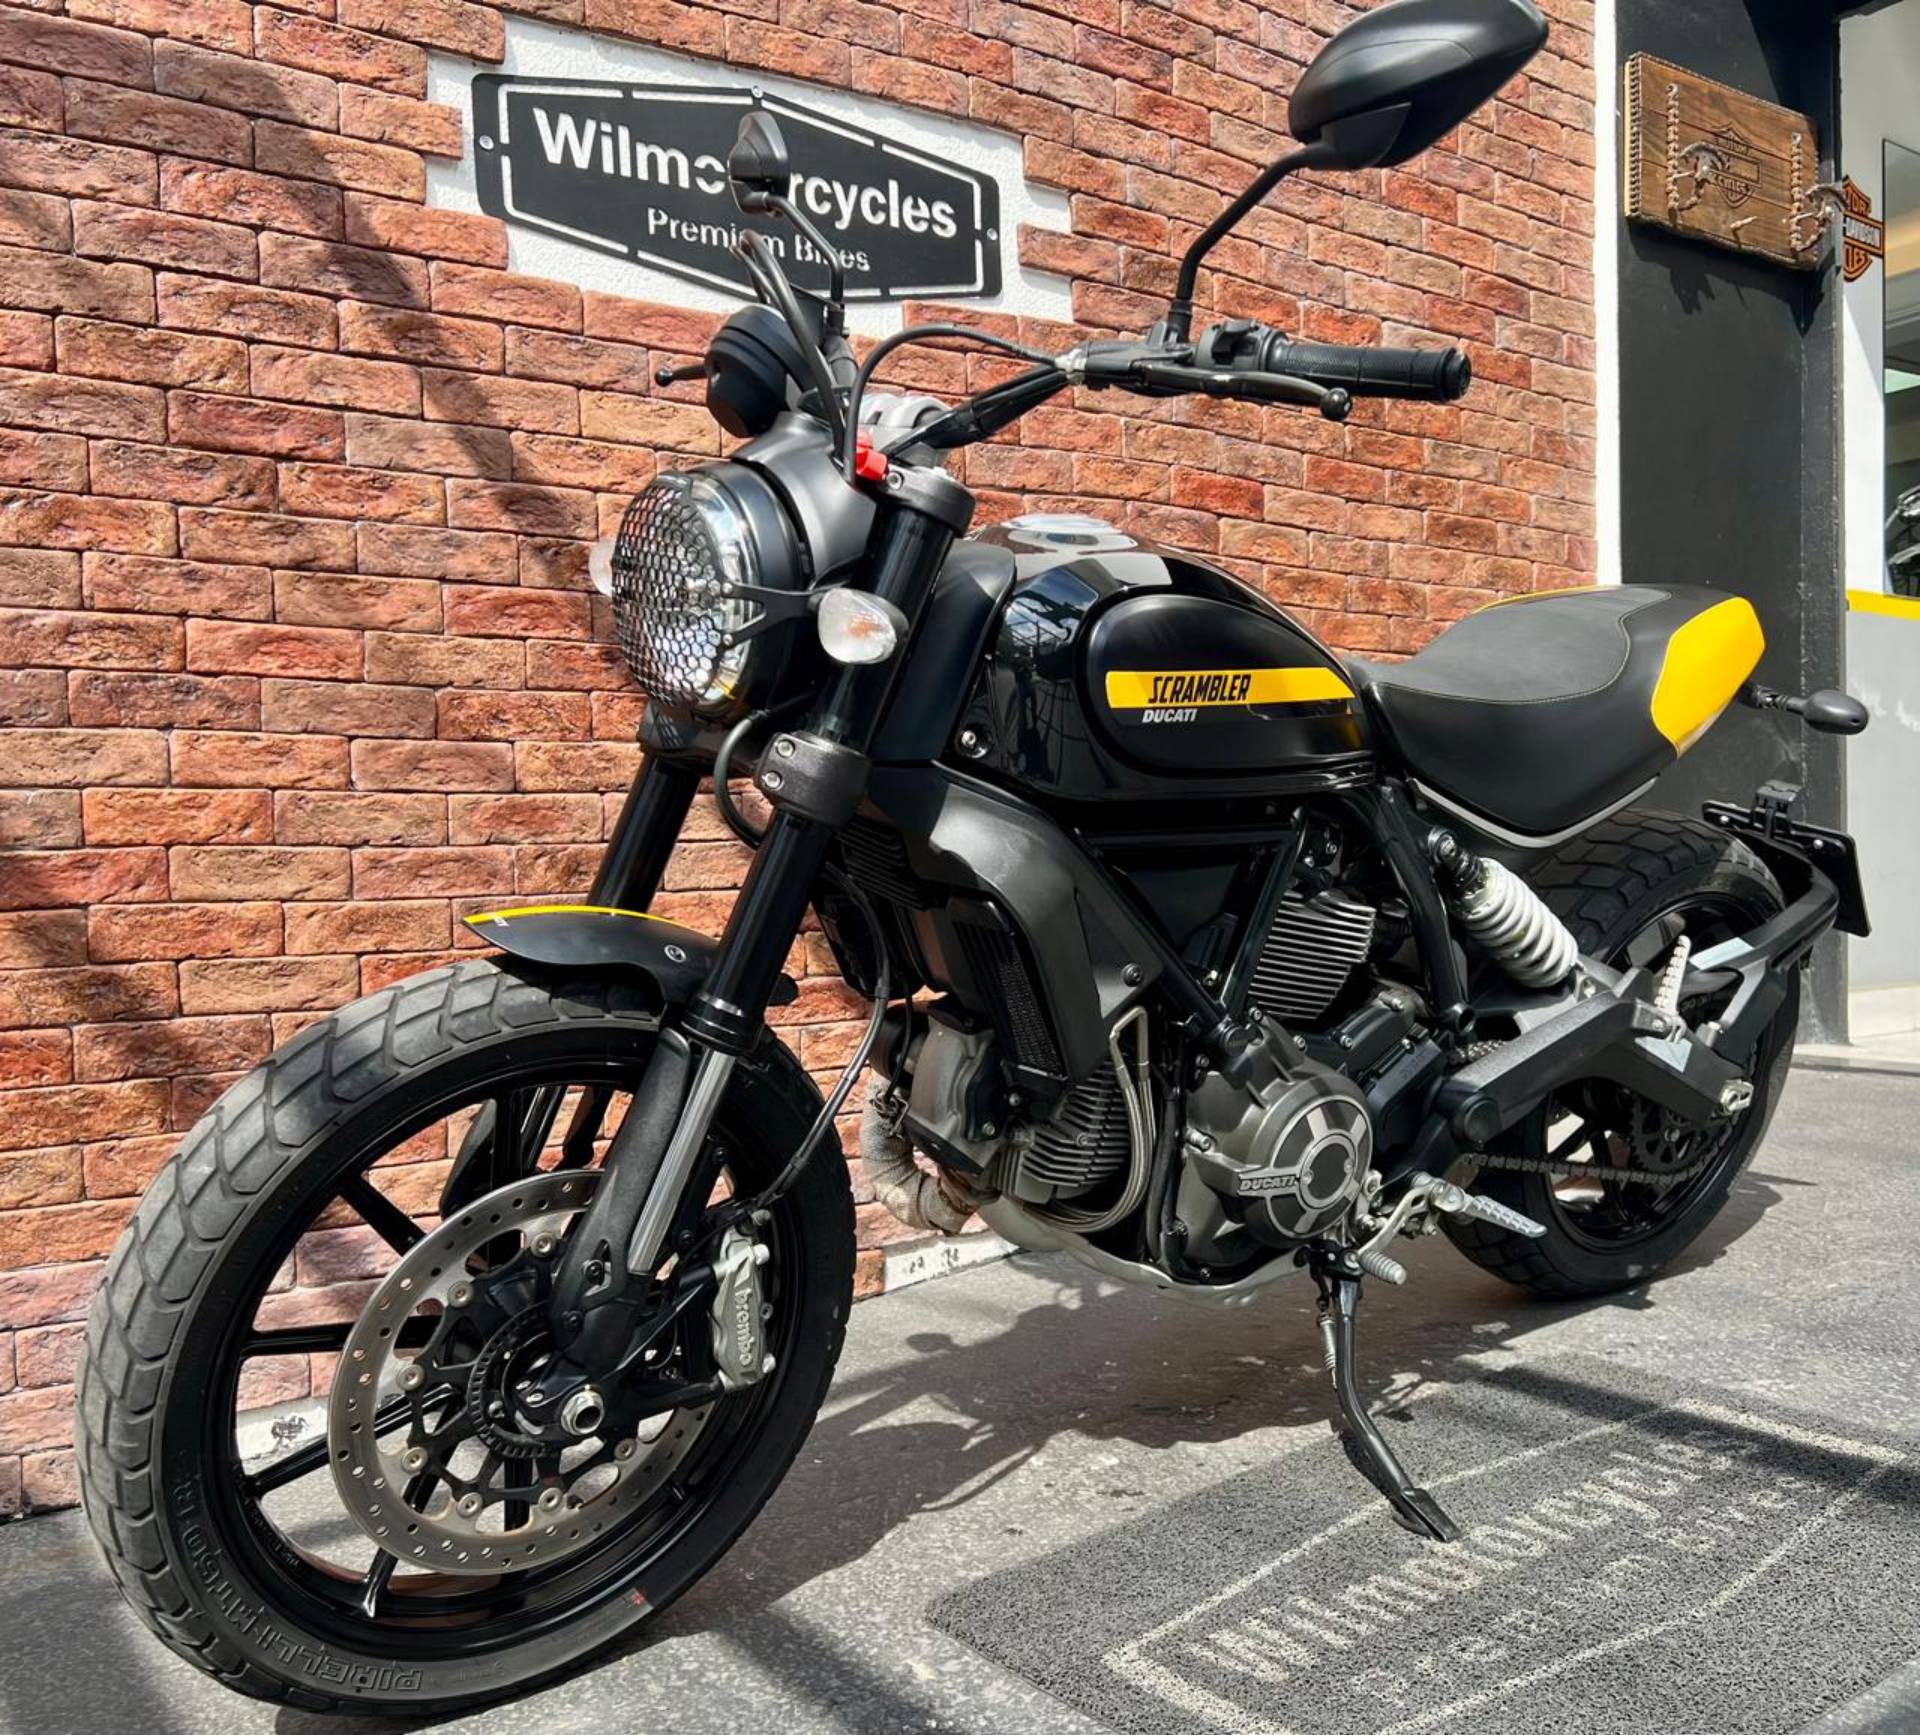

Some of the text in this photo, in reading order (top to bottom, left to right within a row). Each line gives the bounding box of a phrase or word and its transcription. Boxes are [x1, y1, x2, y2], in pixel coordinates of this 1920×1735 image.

[533, 107, 958, 239] Wilmorcycles
[647, 207, 785, 258] Premim
[1148, 674, 1251, 704] SCRAMBLER
[1142, 708, 1197, 723] DUCATI
[1241, 1177, 1295, 1190] DUCATI
[734, 1288, 755, 1366] brembo
[255, 1624, 424, 1692] PIRELLI
